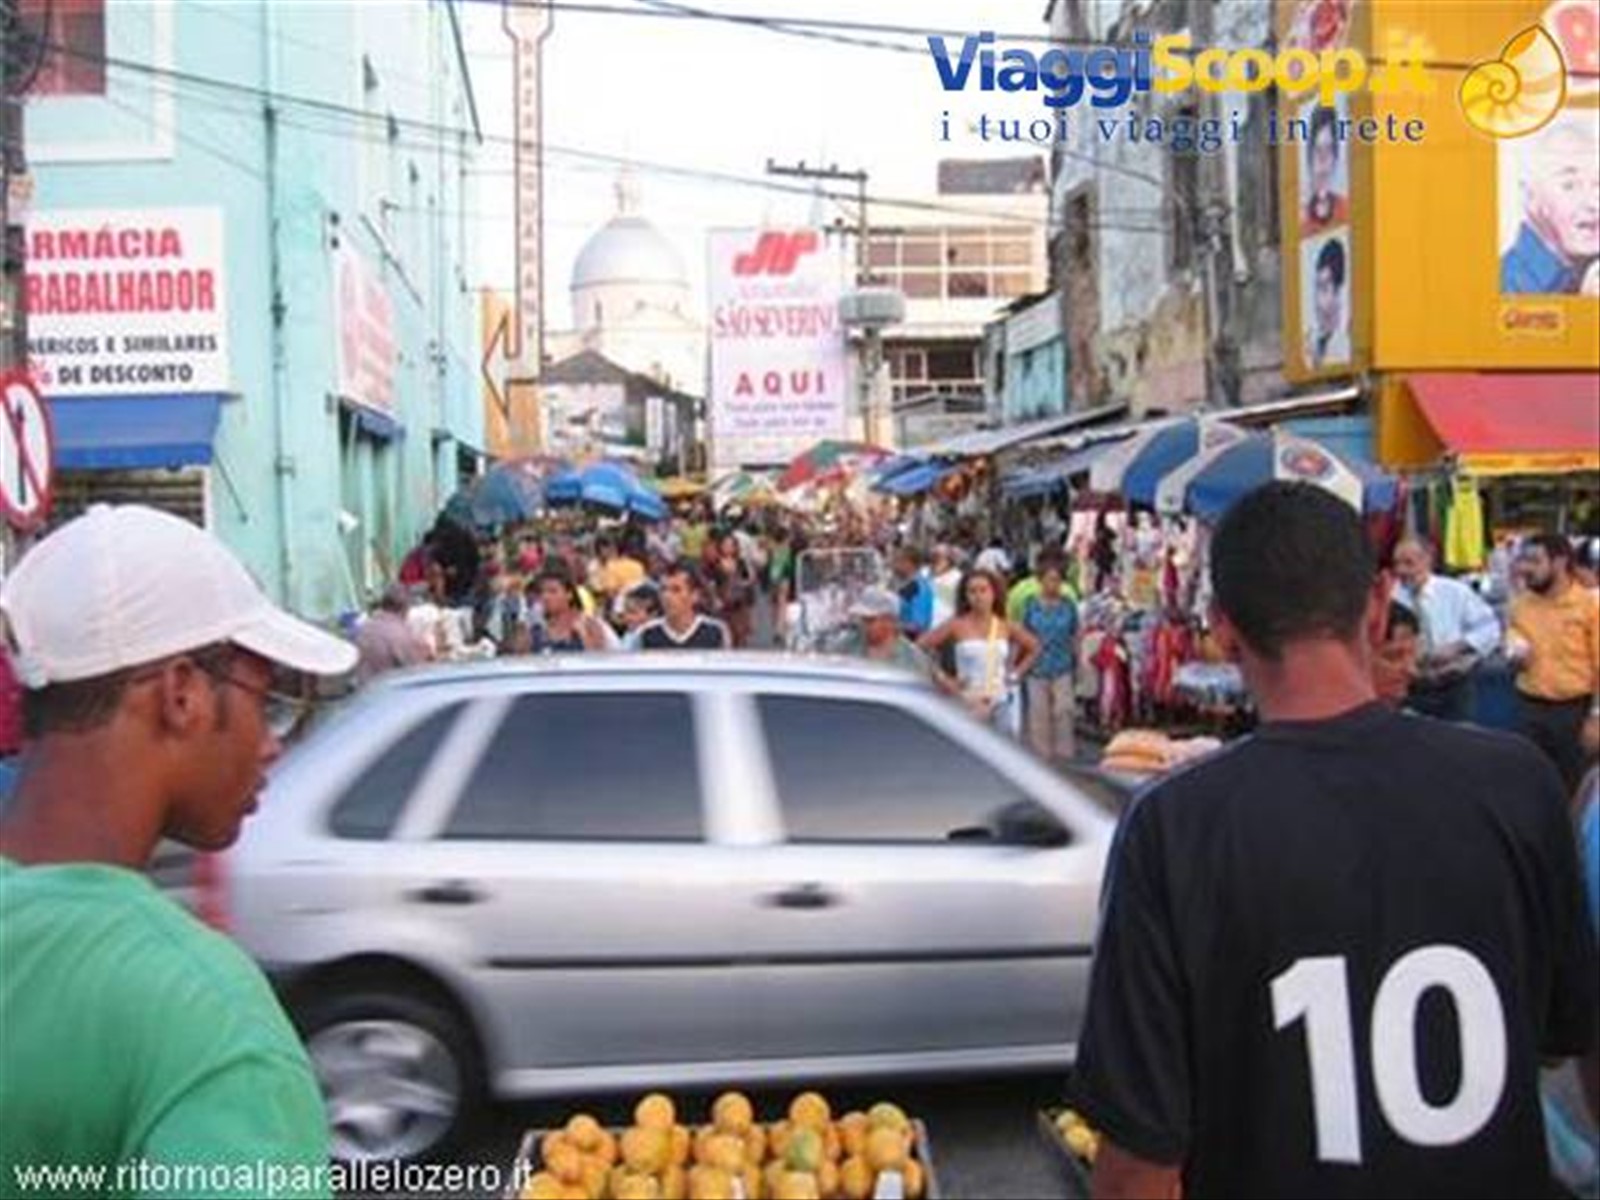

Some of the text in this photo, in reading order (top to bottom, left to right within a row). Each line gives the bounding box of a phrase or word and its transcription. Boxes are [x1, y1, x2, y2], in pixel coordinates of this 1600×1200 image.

[26, 224, 182, 260] RMÁCIA
[23, 269, 215, 315] RABALHADOR
[106, 336, 115, 353] E
[123, 334, 218, 354] SIMILARES
[58, 365, 82, 385] DE
[90, 363, 194, 384] DESCONTO
[1270, 944, 1507, 1166] 10
